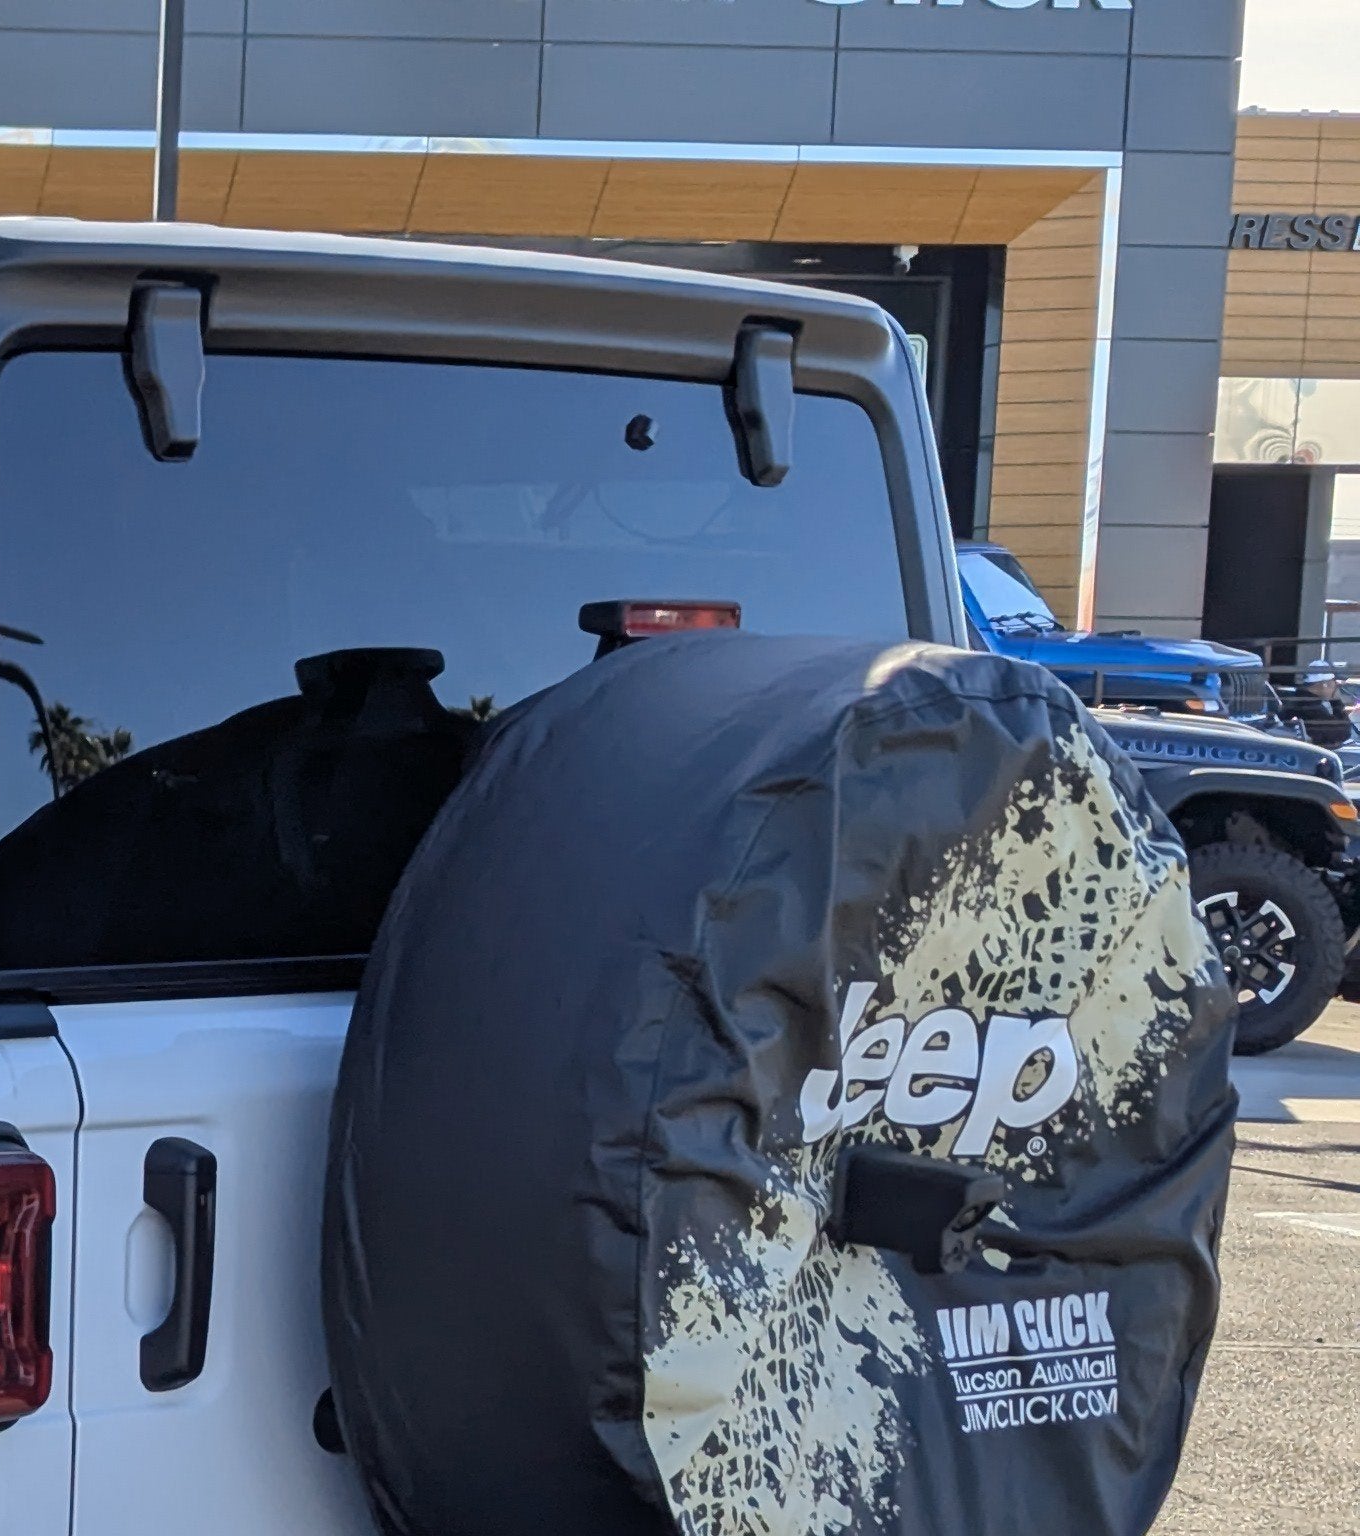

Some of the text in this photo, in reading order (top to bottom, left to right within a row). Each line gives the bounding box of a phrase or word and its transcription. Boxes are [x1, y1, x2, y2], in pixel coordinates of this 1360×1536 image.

[1229, 213, 1350, 250] RESS
[799, 981, 1078, 1155] Jeep
[936, 1291, 1116, 1359] JIM CLICK
[950, 1367, 1022, 1394] Tucson
[961, 1387, 1119, 1434] JIMCLICK.COM
